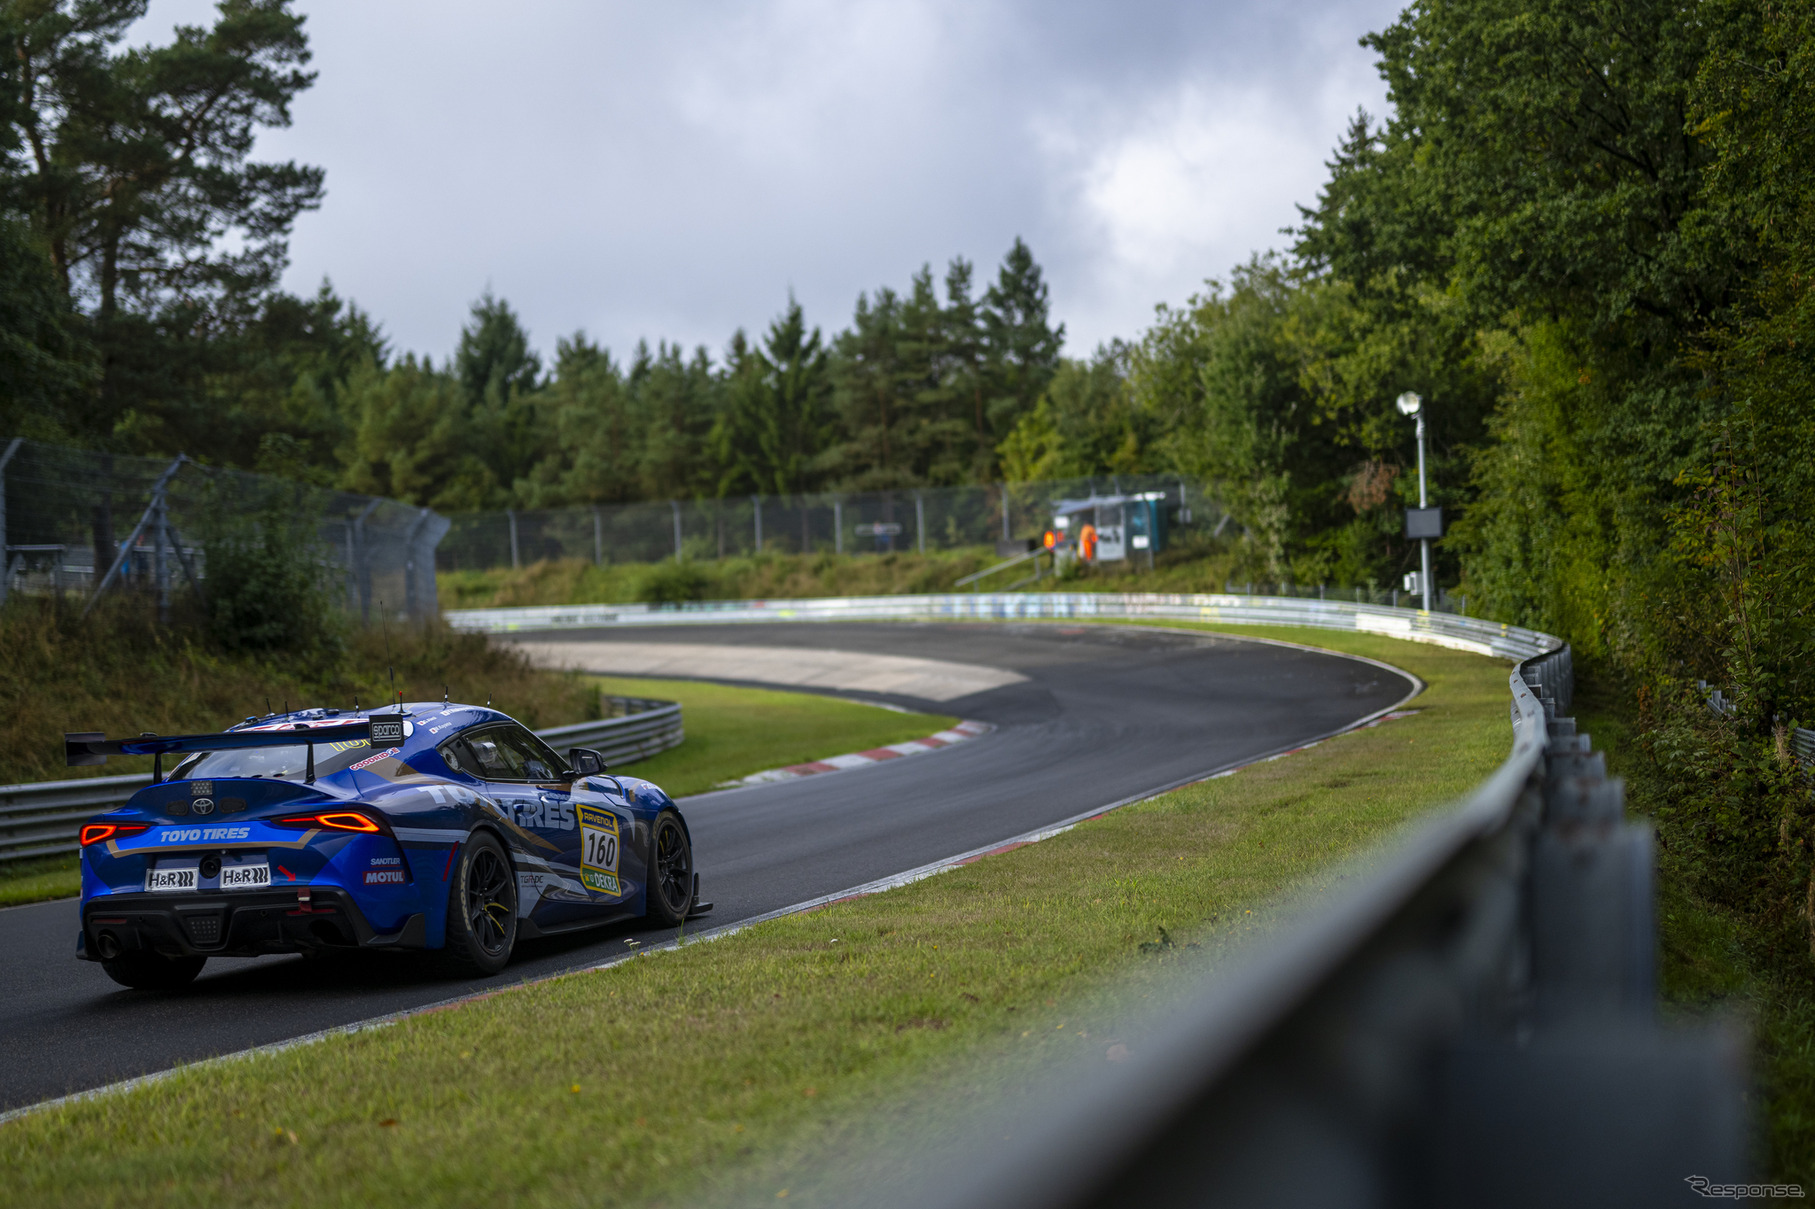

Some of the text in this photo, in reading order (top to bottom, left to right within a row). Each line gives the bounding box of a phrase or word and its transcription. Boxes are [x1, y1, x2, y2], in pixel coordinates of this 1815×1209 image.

[373, 724, 400, 736] sparco
[350, 747, 400, 770] GOODRIDGE
[583, 812, 613, 828] RAVENOL
[161, 828, 250, 842] TOYO TIRES
[588, 832, 616, 867] 160
[149, 872, 176, 888] H&R
[223, 869, 251, 884] H&R
[366, 872, 404, 884] MOTUL
[594, 872, 618, 892] DEKRA
